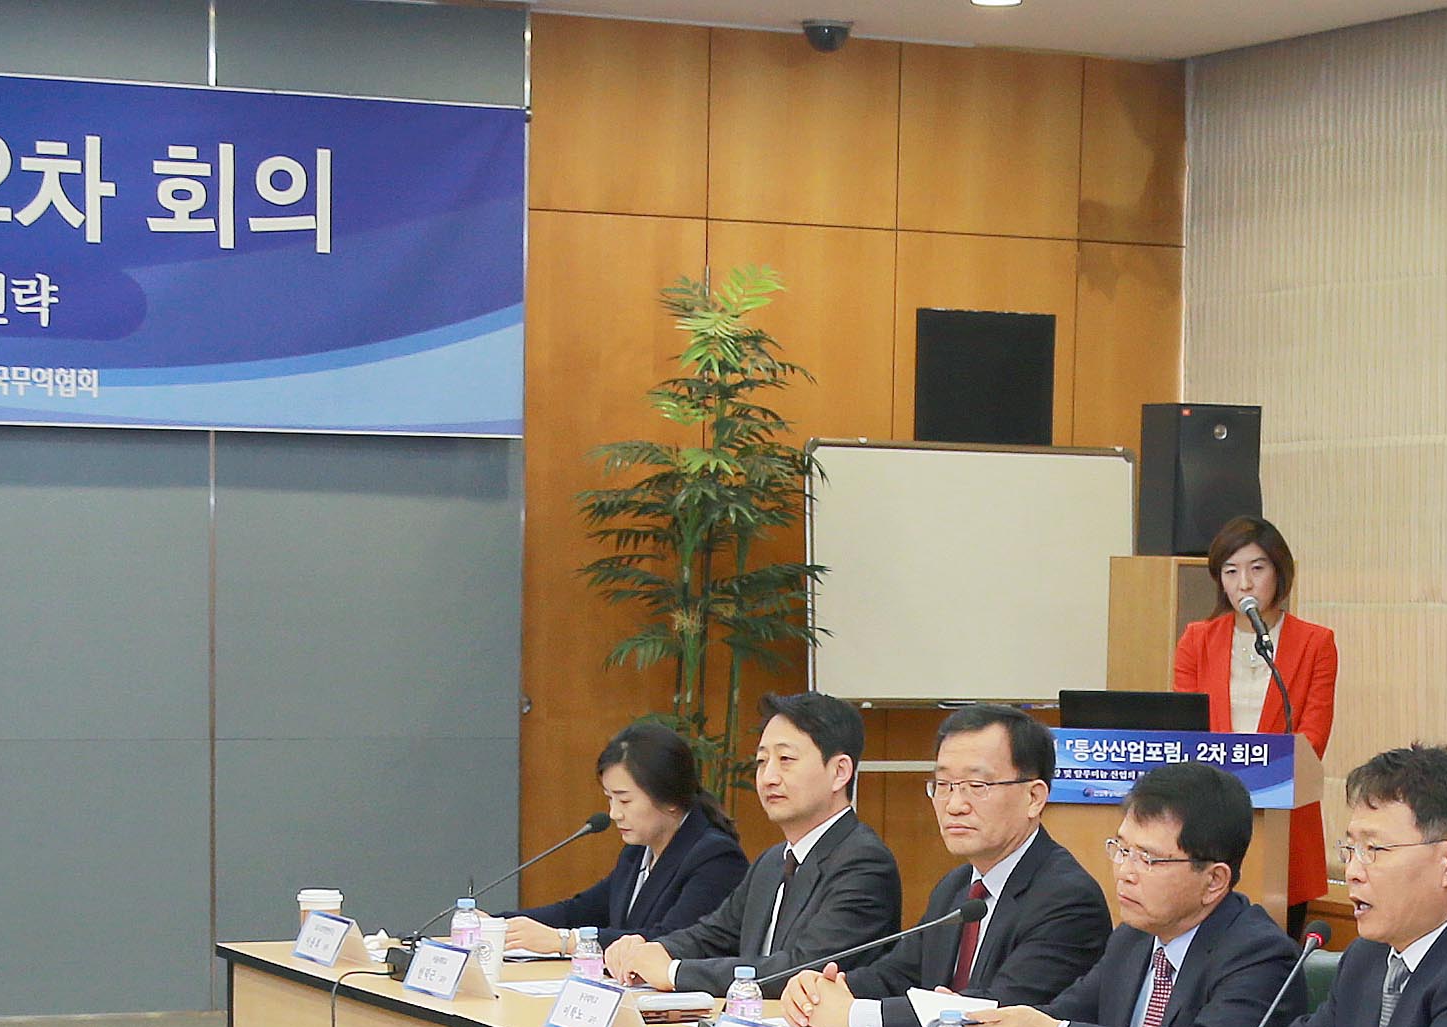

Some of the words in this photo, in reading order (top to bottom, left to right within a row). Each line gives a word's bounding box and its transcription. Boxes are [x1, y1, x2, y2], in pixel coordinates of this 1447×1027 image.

[146, 141, 333, 254] 회의
[1196, 742, 1228, 766] 2차
[1231, 742, 1269, 767] 회의
